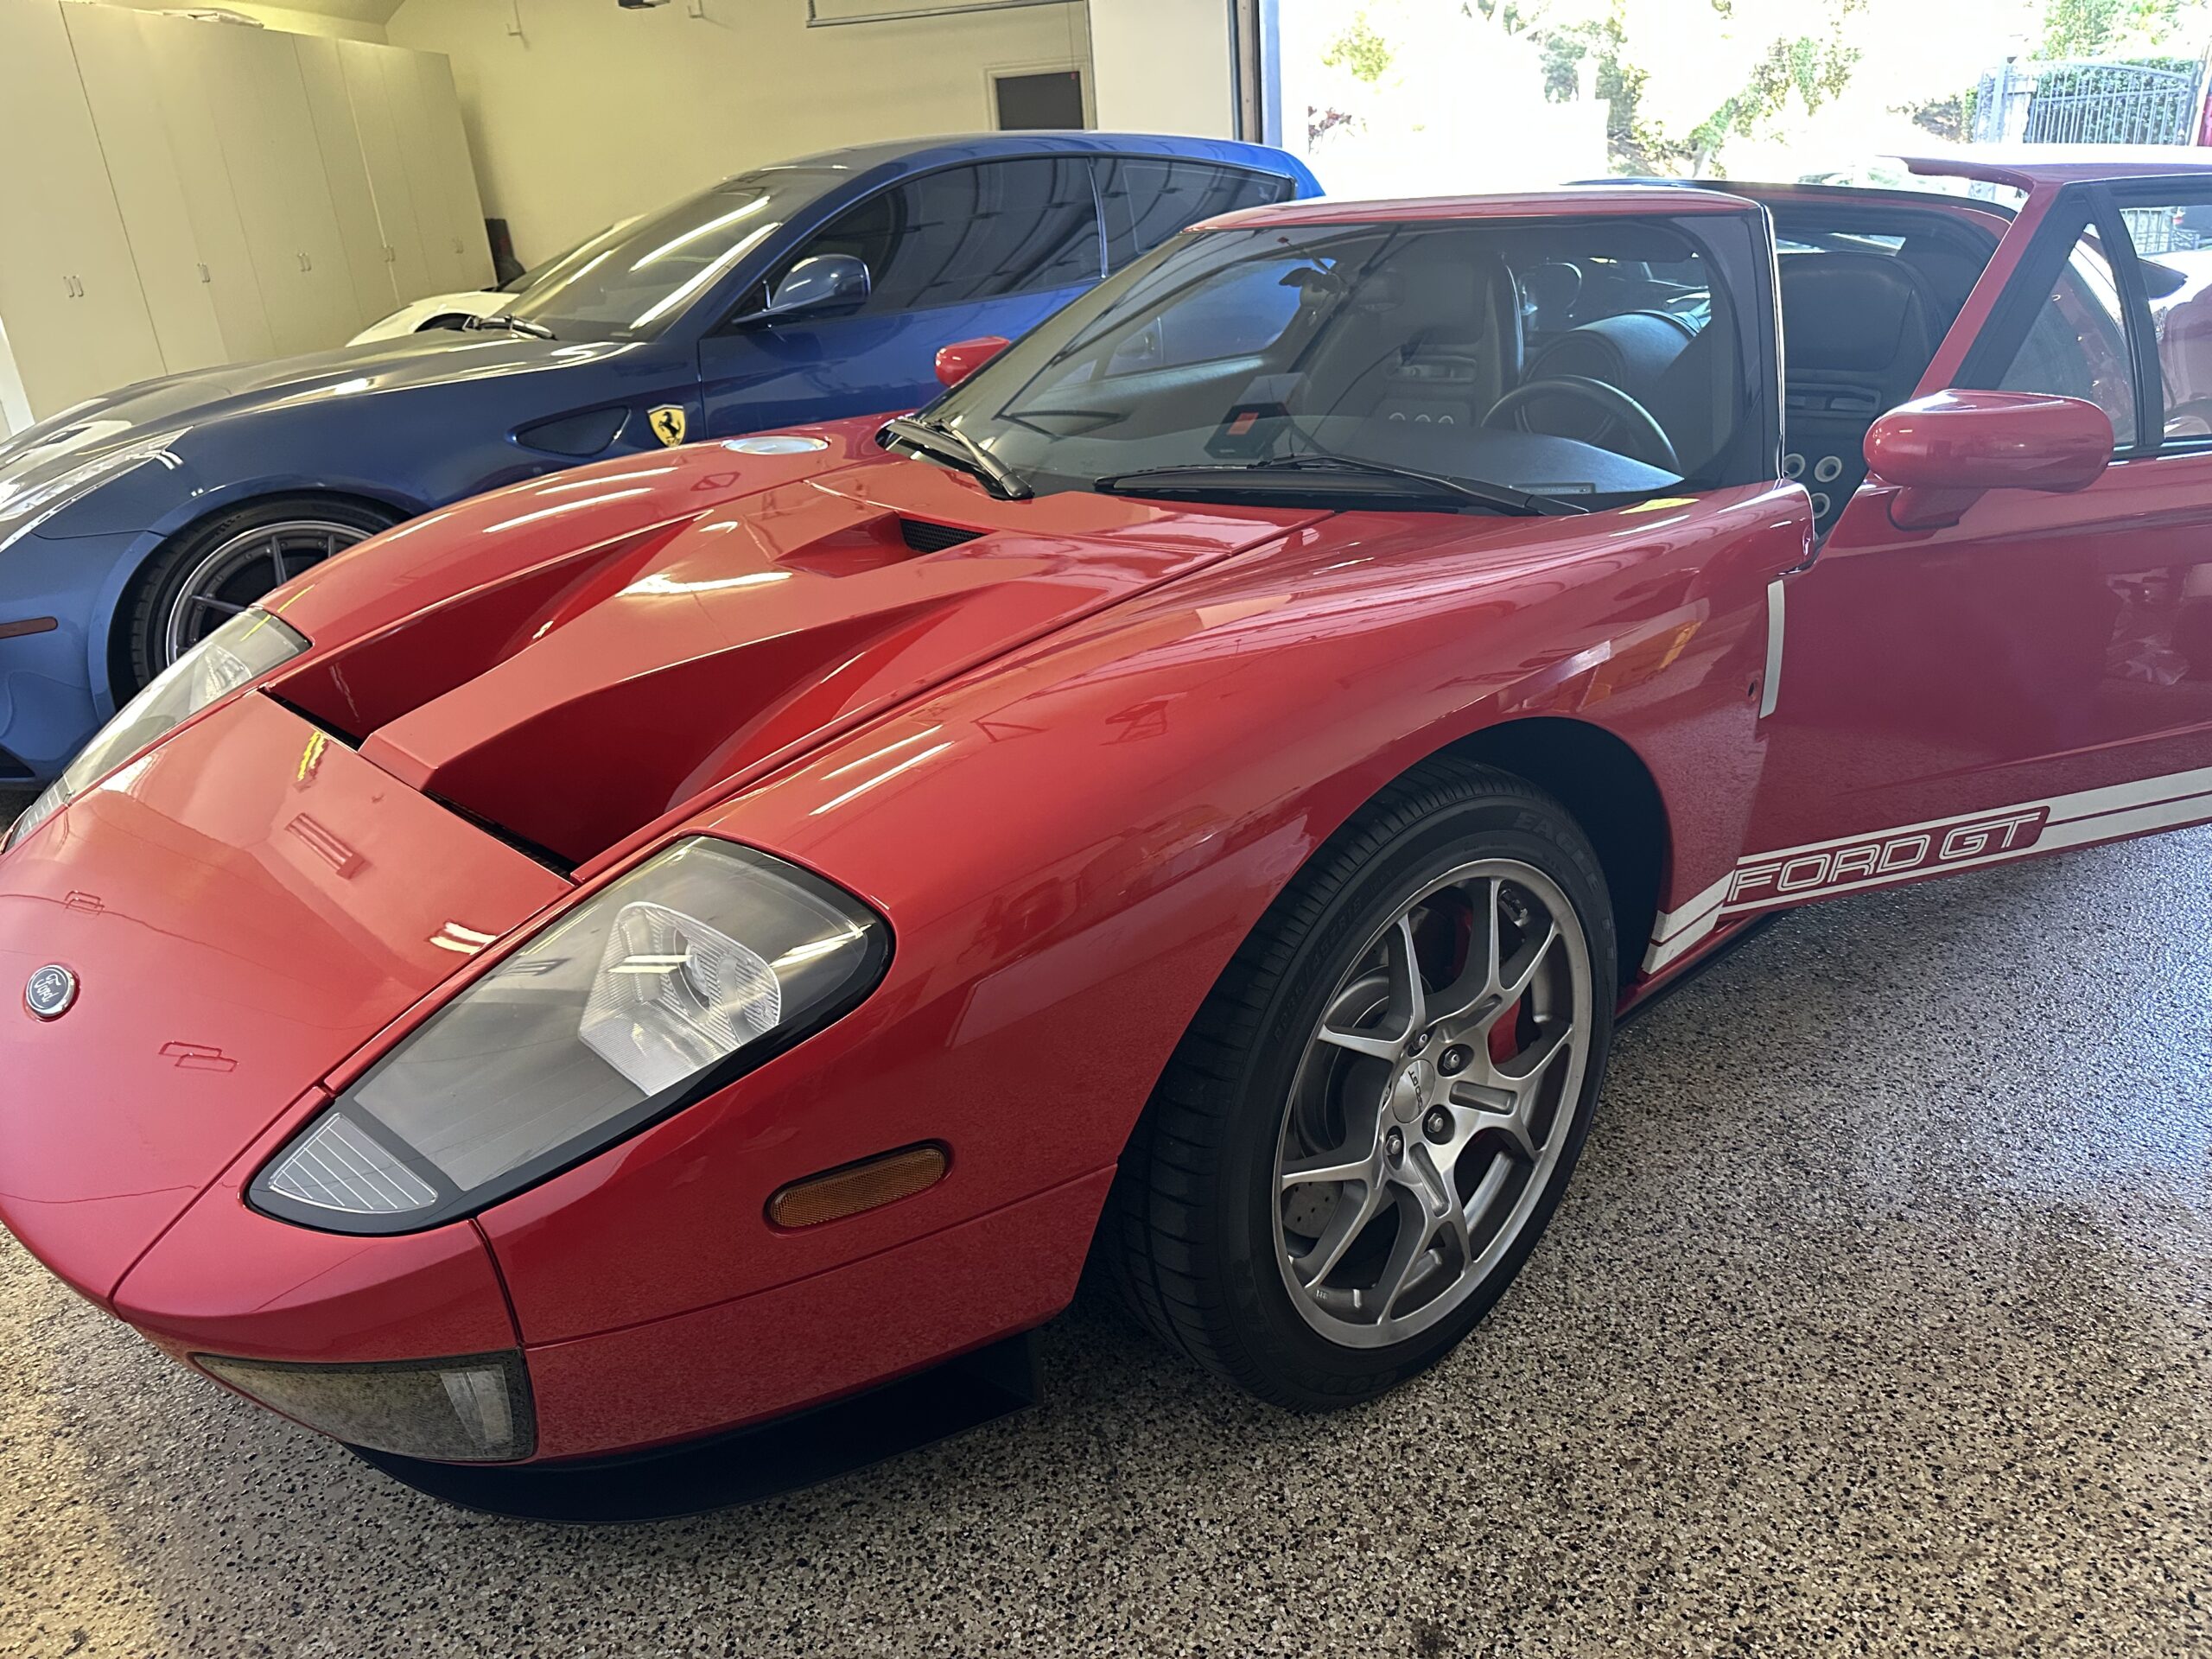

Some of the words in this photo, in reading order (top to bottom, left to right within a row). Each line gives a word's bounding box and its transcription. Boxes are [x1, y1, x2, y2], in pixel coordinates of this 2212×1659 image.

[1513, 810, 1599, 893] EAGLE
[1726, 834, 1931, 902] FORD
[1938, 811, 2041, 860] GT
